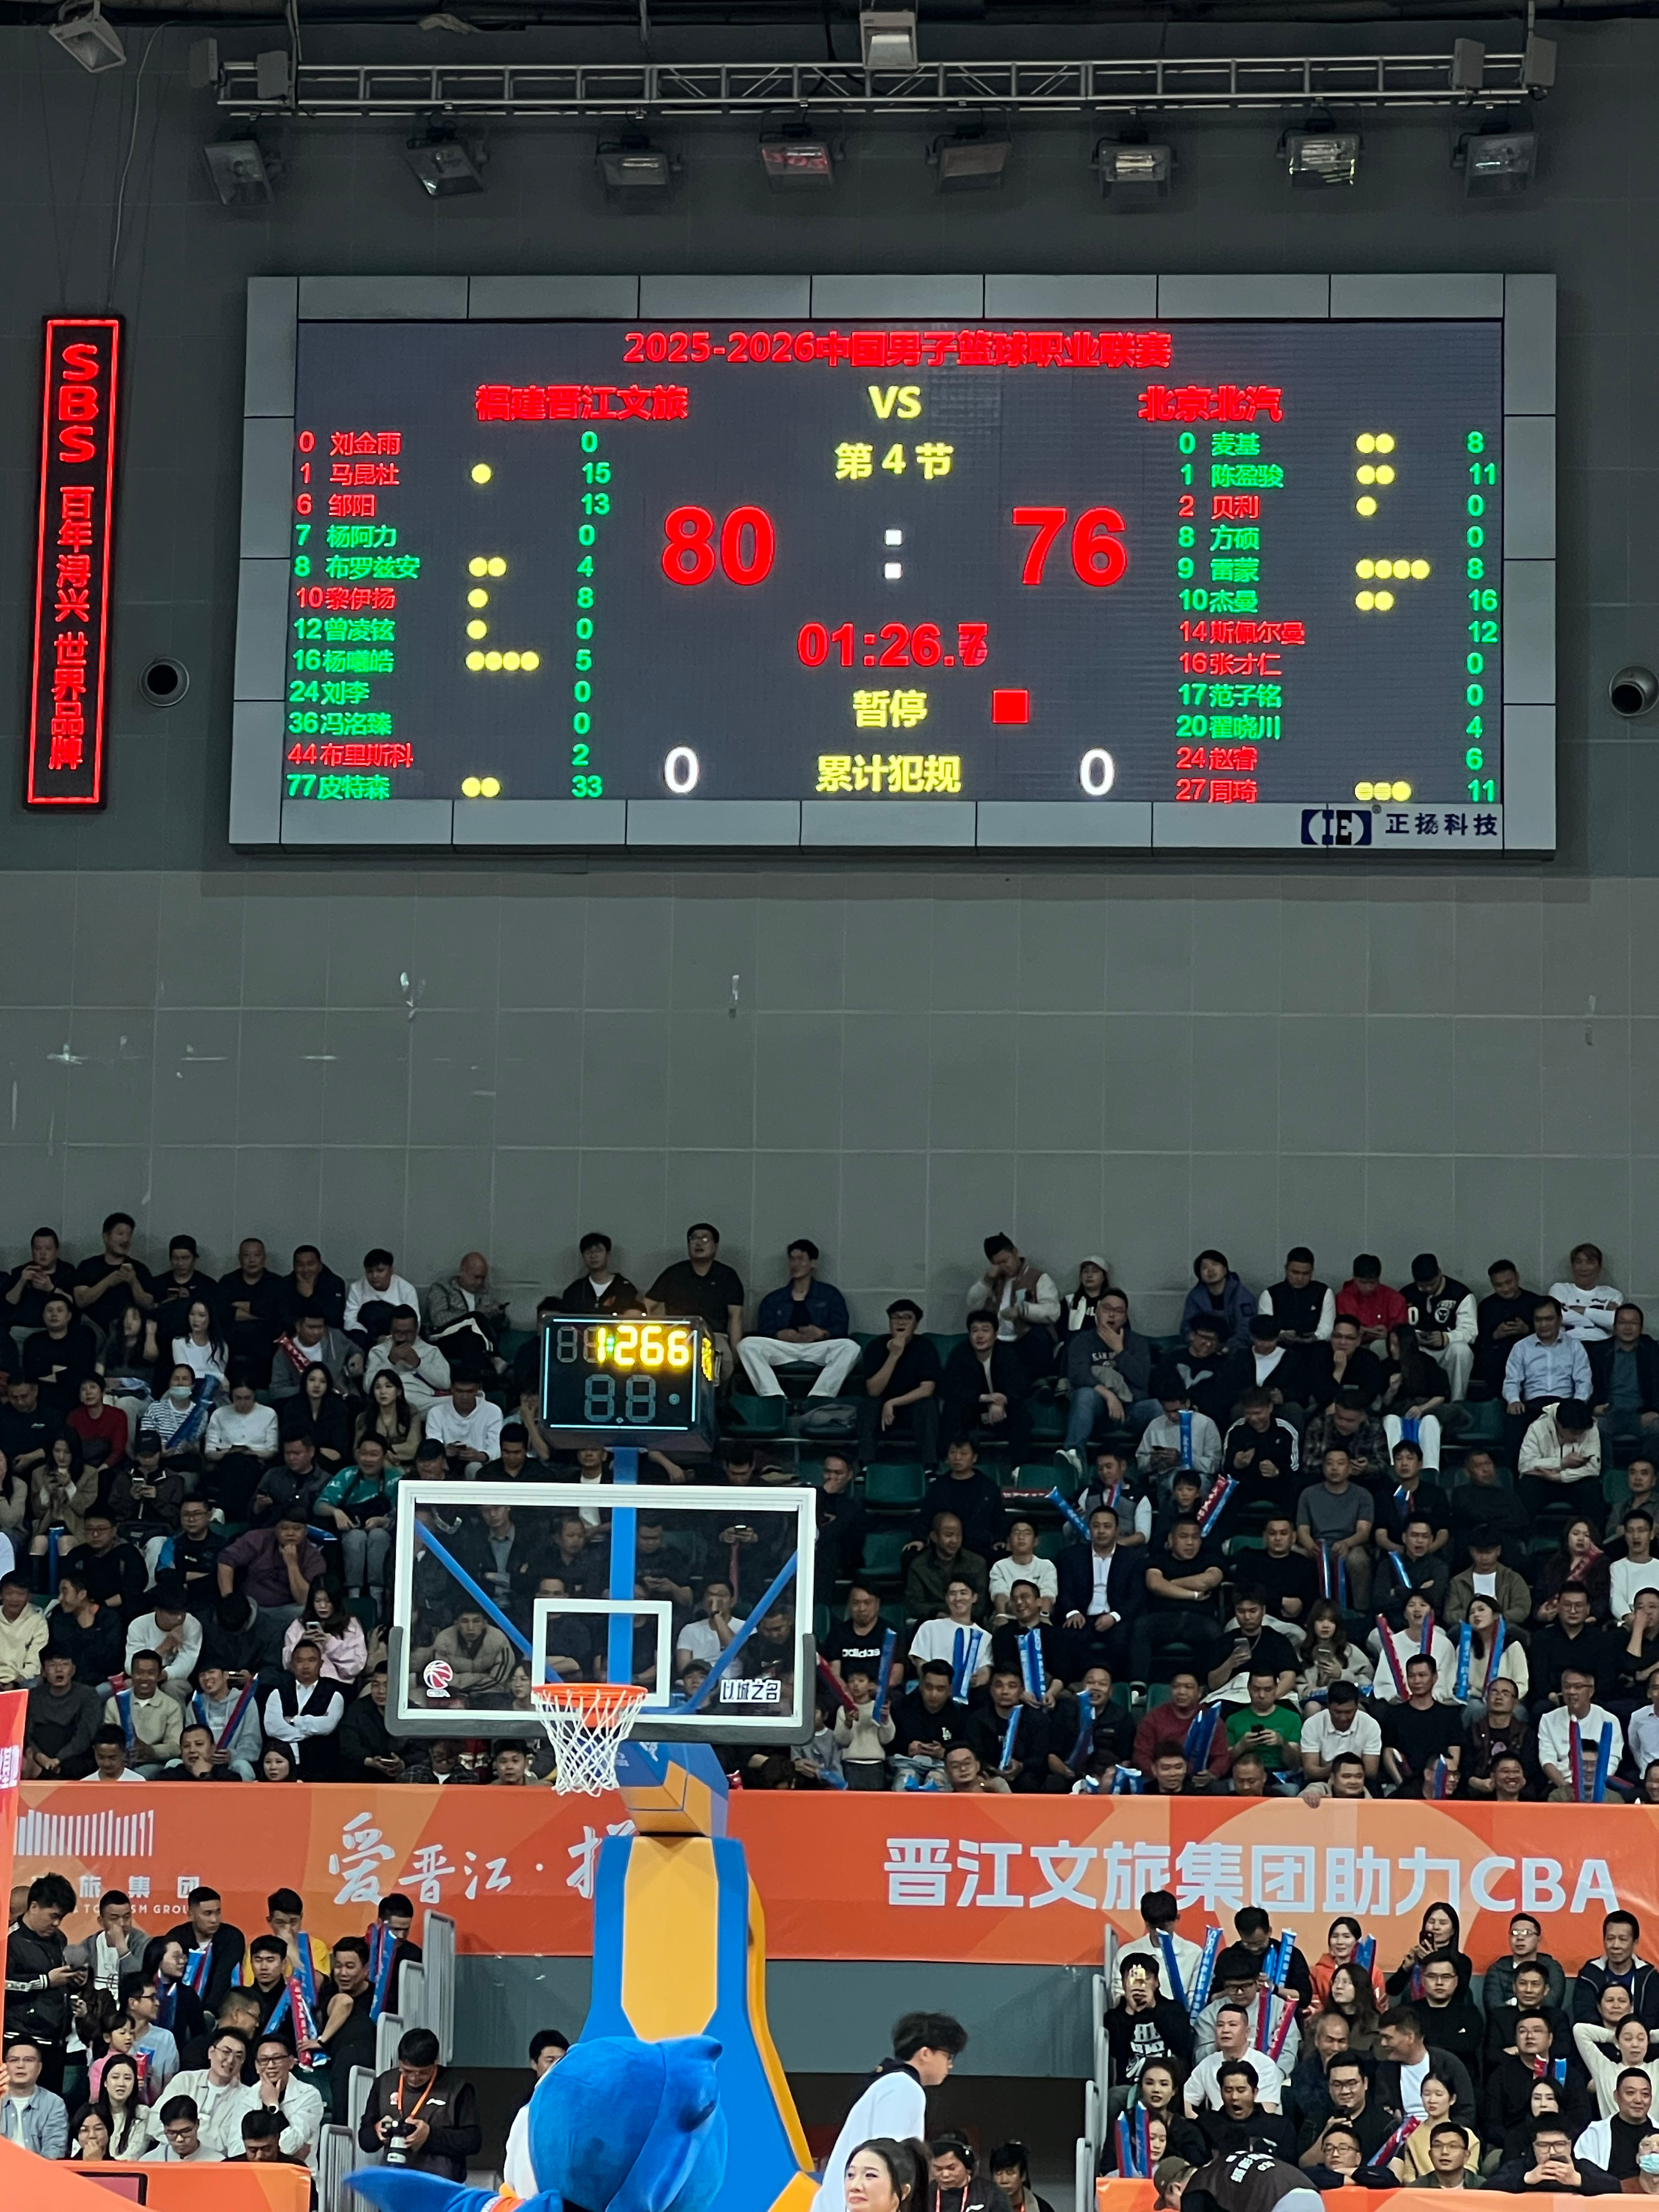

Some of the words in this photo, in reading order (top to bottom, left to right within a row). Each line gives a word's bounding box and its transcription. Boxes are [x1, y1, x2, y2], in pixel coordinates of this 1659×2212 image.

[59, 343, 99, 462] SBS
[475, 385, 689, 421] 福建晋江文旅
[868, 385, 923, 420] VS
[1138, 384, 1284, 422] 北京北汽
[298, 431, 315, 453] 0
[330, 431, 401, 456] 刘金雨
[582, 431, 597, 453] 0
[1179, 432, 1195, 454] 0
[1211, 431, 1260, 456] 麦基
[1467, 431, 1483, 453] 8
[301, 463, 311, 483] 1
[330, 462, 399, 487] 马昆杜
[582, 462, 611, 484] 15
[1181, 464, 1193, 485] 1
[1211, 464, 1284, 488] 陈盈骏
[1469, 462, 1496, 485] 11
[297, 493, 312, 515] 6
[328, 493, 376, 517] 邹阳
[582, 493, 610, 515] 13
[1179, 495, 1195, 517] 2
[1213, 495, 1261, 520] 贝利
[1468, 494, 1484, 516] 0
[296, 524, 311, 546] 7
[326, 524, 396, 548] 杨阿力
[579, 524, 595, 546] 0
[662, 505, 776, 586] 80
[1013, 506, 1128, 588] 76
[1178, 526, 1195, 548] 8
[1210, 524, 1260, 551] 方硕
[1467, 526, 1483, 548] 0
[294, 555, 311, 577] 8
[325, 555, 420, 580] 布罗兹安
[577, 556, 594, 577] 4
[1178, 557, 1194, 579] 9
[1210, 557, 1260, 583] 雷蒙
[1467, 558, 1484, 579] 8
[297, 586, 324, 608] 10
[324, 586, 397, 610] 黎伊扬
[577, 586, 593, 608] 8
[1179, 589, 1208, 611] 10
[1209, 589, 1258, 613] 杰曼
[1469, 589, 1497, 612] 16
[294, 618, 322, 639] 12
[324, 617, 395, 641] 曾凌铉
[577, 618, 593, 639] 0
[1180, 620, 1207, 642] 14
[1207, 620, 1305, 645] 斯佩尔曼
[1469, 621, 1498, 643] 12
[293, 649, 321, 671] 16
[575, 649, 591, 671] 5
[1180, 652, 1208, 673] 16
[1208, 652, 1282, 676] 张才仁
[1467, 652, 1483, 674] 0
[48, 631, 88, 770] 世界品牌
[289, 680, 319, 702] 24
[321, 680, 370, 706] 刘李
[574, 680, 591, 702] 0
[1178, 683, 1207, 706] 17
[1209, 684, 1282, 708] 范子铭
[1467, 684, 1483, 707] 0
[852, 689, 928, 729] 暂停
[289, 712, 319, 733] 36
[573, 712, 590, 734] 0
[1176, 714, 1207, 737] 20
[1209, 714, 1280, 740] 翟晓川
[1466, 716, 1482, 738] 4
[287, 743, 318, 764] 44
[319, 743, 413, 768] 布里斯科
[572, 743, 589, 766] 2
[1176, 747, 1207, 770] 24
[1207, 746, 1258, 771] 赵睿
[1466, 748, 1483, 770] 6
[664, 747, 699, 794] 0
[815, 754, 962, 794] 累计犯规
[1080, 748, 1115, 795] 0
[287, 774, 317, 797] 77
[317, 774, 390, 801] 皮特森
[572, 775, 602, 797] 33
[1176, 777, 1207, 801] 27
[1208, 778, 1258, 803] 周琦
[1468, 779, 1494, 802] 11
[1385, 812, 1498, 836] 正扬科技
[329, 1812, 636, 1904] 爱晋江·
[884, 1838, 1621, 1914] 晋江文旅集团助力CBA
